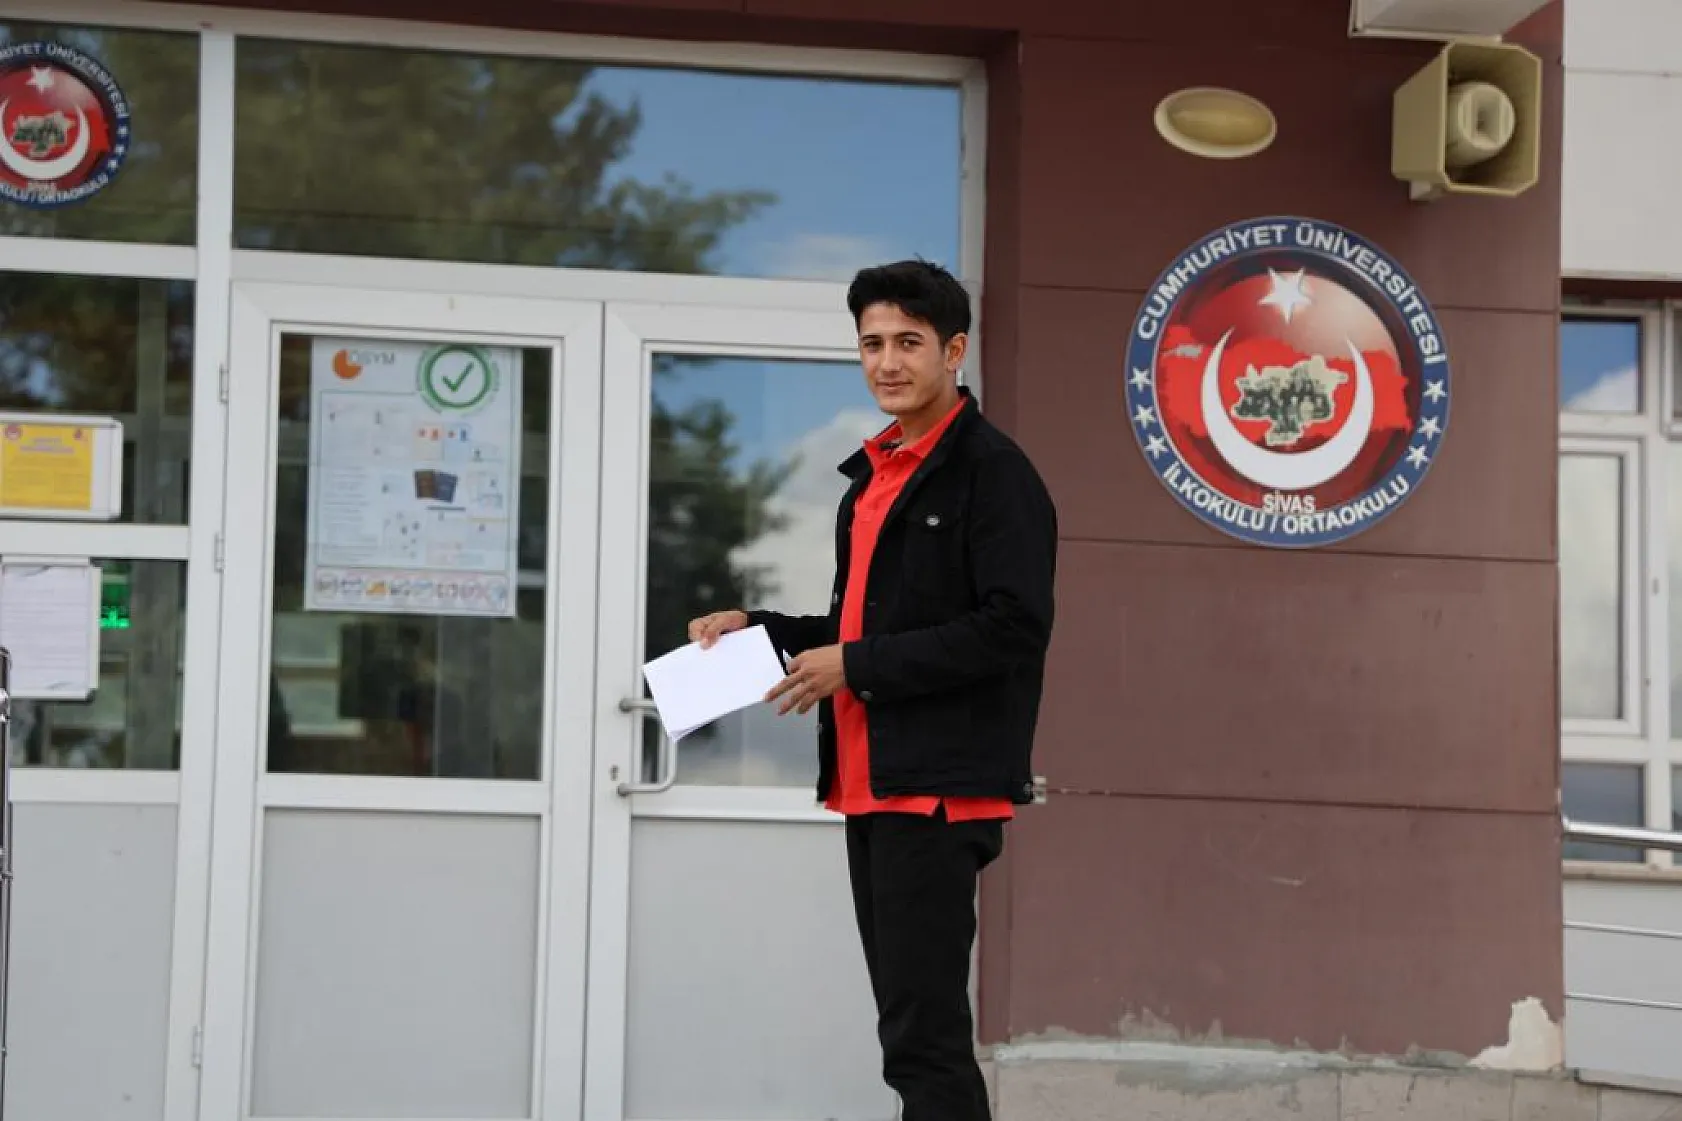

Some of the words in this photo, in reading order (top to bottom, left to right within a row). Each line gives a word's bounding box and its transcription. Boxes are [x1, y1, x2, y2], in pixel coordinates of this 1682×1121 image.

[1137, 224, 1288, 341] CUMHURİYET
[1295, 222, 1447, 364] ÜNİVERSİTESİ
[1163, 462, 1266, 531] İLKOKULU
[1281, 474, 1410, 535] ORTAOKULU
[1262, 489, 1316, 515] SİVAS
